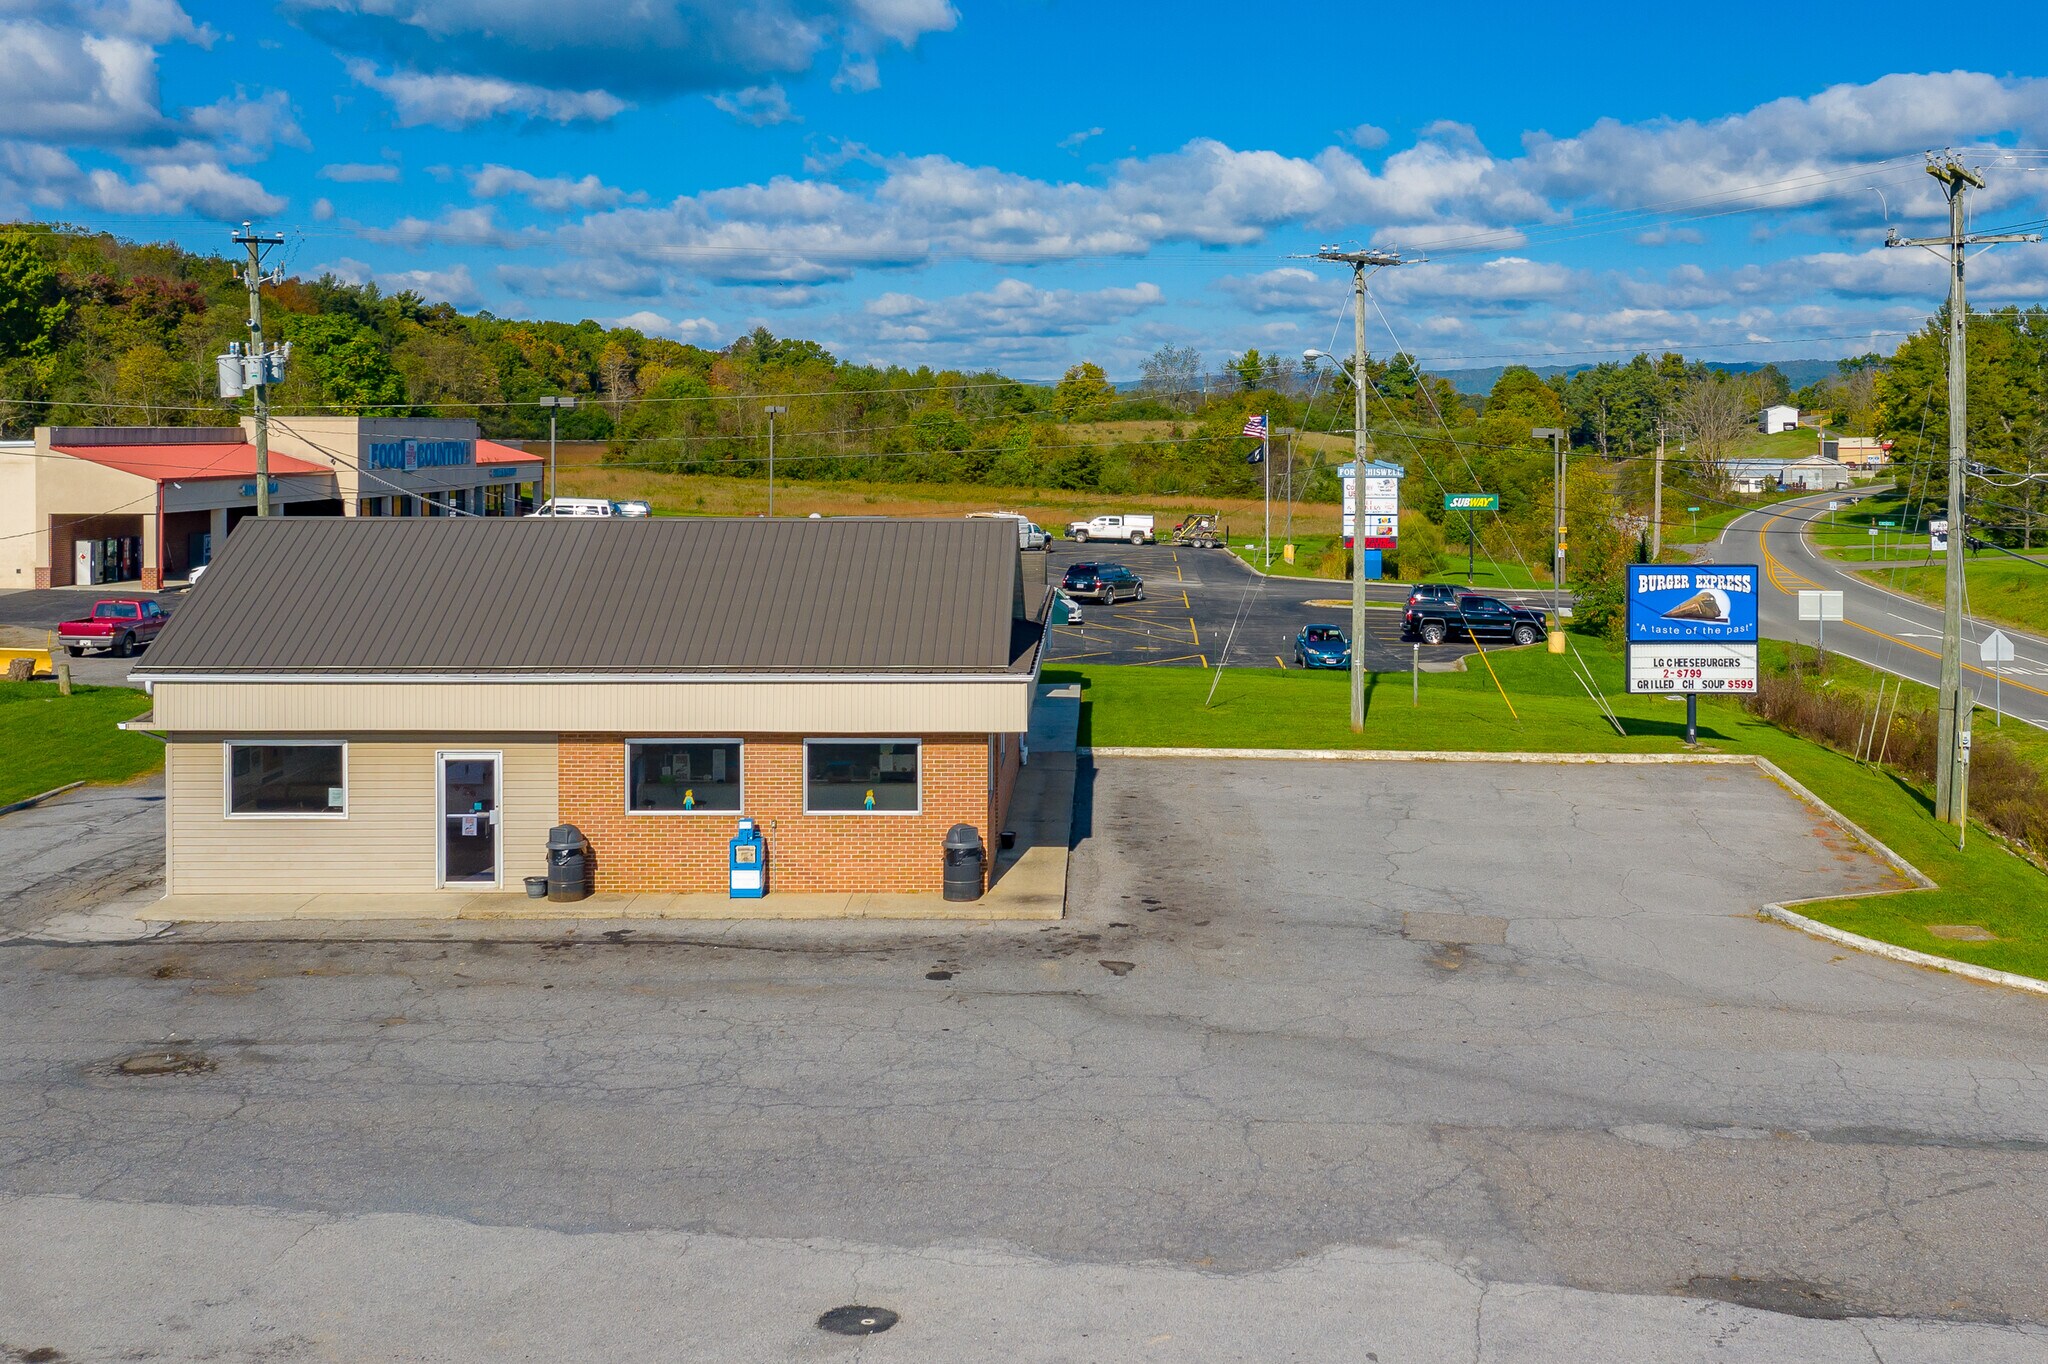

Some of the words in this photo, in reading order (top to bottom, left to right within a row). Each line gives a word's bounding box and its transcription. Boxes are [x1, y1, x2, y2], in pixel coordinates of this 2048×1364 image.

[1339, 468, 1356, 476] FOR
[1449, 496, 1494, 508] SUBWAY
[1638, 574, 1690, 594] BURGER
[1695, 574, 1751, 594] EXPRESS
[1651, 625, 1680, 635] taste
[1686, 626, 1697, 635] of
[1702, 626, 1721, 635] the
[1653, 659, 1665, 668] LG
[1666, 658, 1741, 668] CHEESEBURGERS
[1637, 680, 1674, 690] GRILLED
[1682, 680, 1694, 689] CH
[1702, 680, 1725, 689] SOUP
[1728, 679, 1753, 689] $599
